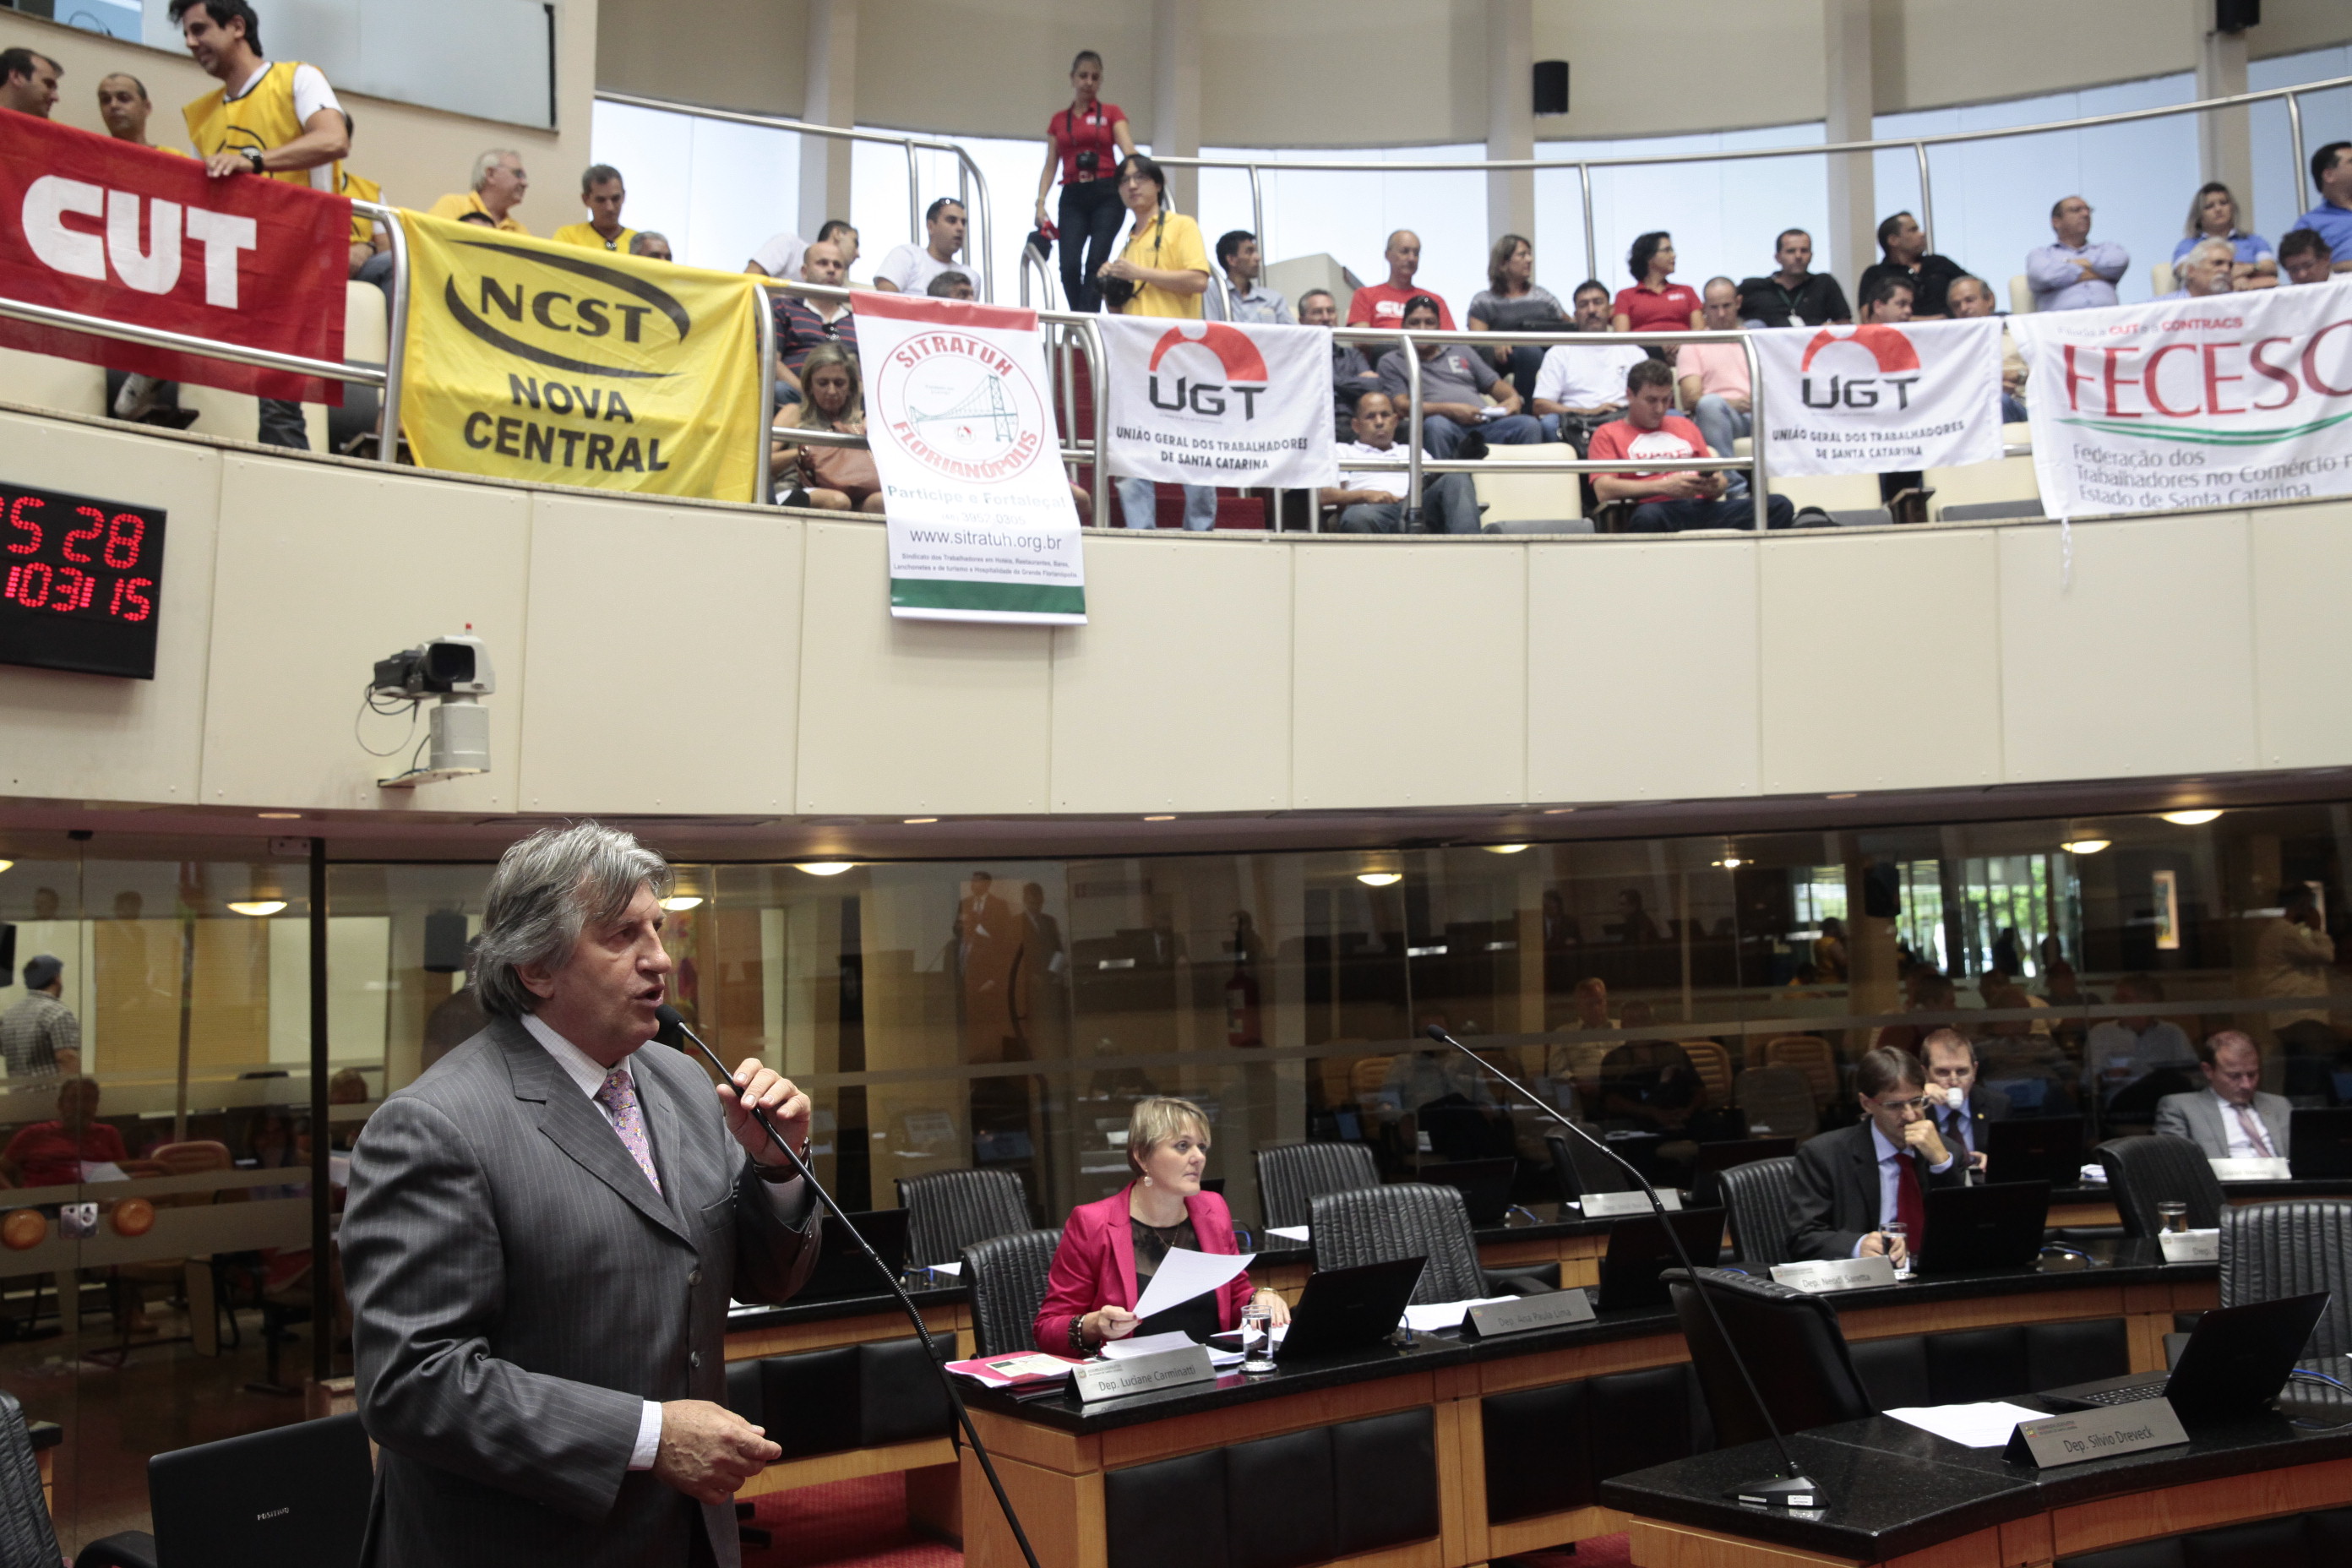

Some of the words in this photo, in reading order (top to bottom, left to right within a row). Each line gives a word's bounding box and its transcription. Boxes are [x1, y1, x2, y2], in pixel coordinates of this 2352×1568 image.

[22, 175, 257, 309] CUT
[481, 275, 651, 343] NCST
[2109, 323, 2139, 335] CUT
[2160, 317, 2244, 332] CONTRACS
[896, 336, 1013, 377] SITRATUH
[508, 373, 634, 423] NOVA
[1149, 375, 1267, 422] UGT
[1801, 374, 1920, 411] UGT
[465, 411, 670, 472] CENTRAL
[1116, 425, 1152, 442] UNIÃO
[1155, 433, 1189, 448] GERAL
[1192, 438, 1214, 450] DOS
[1217, 438, 1308, 452] TRABALHADORES
[1772, 424, 1808, 441] UNIÃO
[1810, 431, 1842, 443] GERAL
[1845, 431, 1867, 443] DOS
[1870, 420, 1964, 443] TRABALHADORES
[893, 422, 1037, 478] FLORIANÓPOLIS
[1161, 450, 1173, 462] DE
[1178, 453, 1212, 468] SANTA
[1216, 457, 1269, 471] CATARINA
[1816, 448, 1827, 459] DE
[1831, 446, 1865, 459] SANTA
[1870, 445, 1923, 459] CATARINA
[2073, 444, 2163, 468] Federação
[2169, 449, 2206, 466] dos
[2077, 465, 2198, 490] Trabalhadores
[2206, 471, 2233, 486] no
[2239, 455, 2337, 484] Comércio
[887, 485, 964, 504] Participe
[968, 493, 978, 504] e
[2079, 486, 2134, 508] Estado
[2139, 490, 2163, 507] de
[2169, 491, 2223, 508] Santa
[2228, 482, 2312, 505] Catarina
[63, 506, 144, 569] 28
[909, 530, 1063, 553] www.sitratuh.org.br
[894, 563, 931, 571] Lanchonetes
[974, 566, 1012, 576] Hospitalidade
[1021, 569, 1042, 577] Grande
[944, 554, 984, 564] Trabalhadores
[1518, 1315, 1533, 1323] Ana
[1533, 1311, 1554, 1320] Paula
[1553, 1309, 1573, 1319] Lima
[1098, 1380, 1120, 1393] Dep.
[1120, 1374, 1152, 1388] Luciane
[1154, 1364, 1196, 1382] Carminatti
[2063, 1438, 2089, 1454] Dep.
[2088, 1433, 2115, 1449] Silvio
[2115, 1424, 2155, 1444] Dreveck
